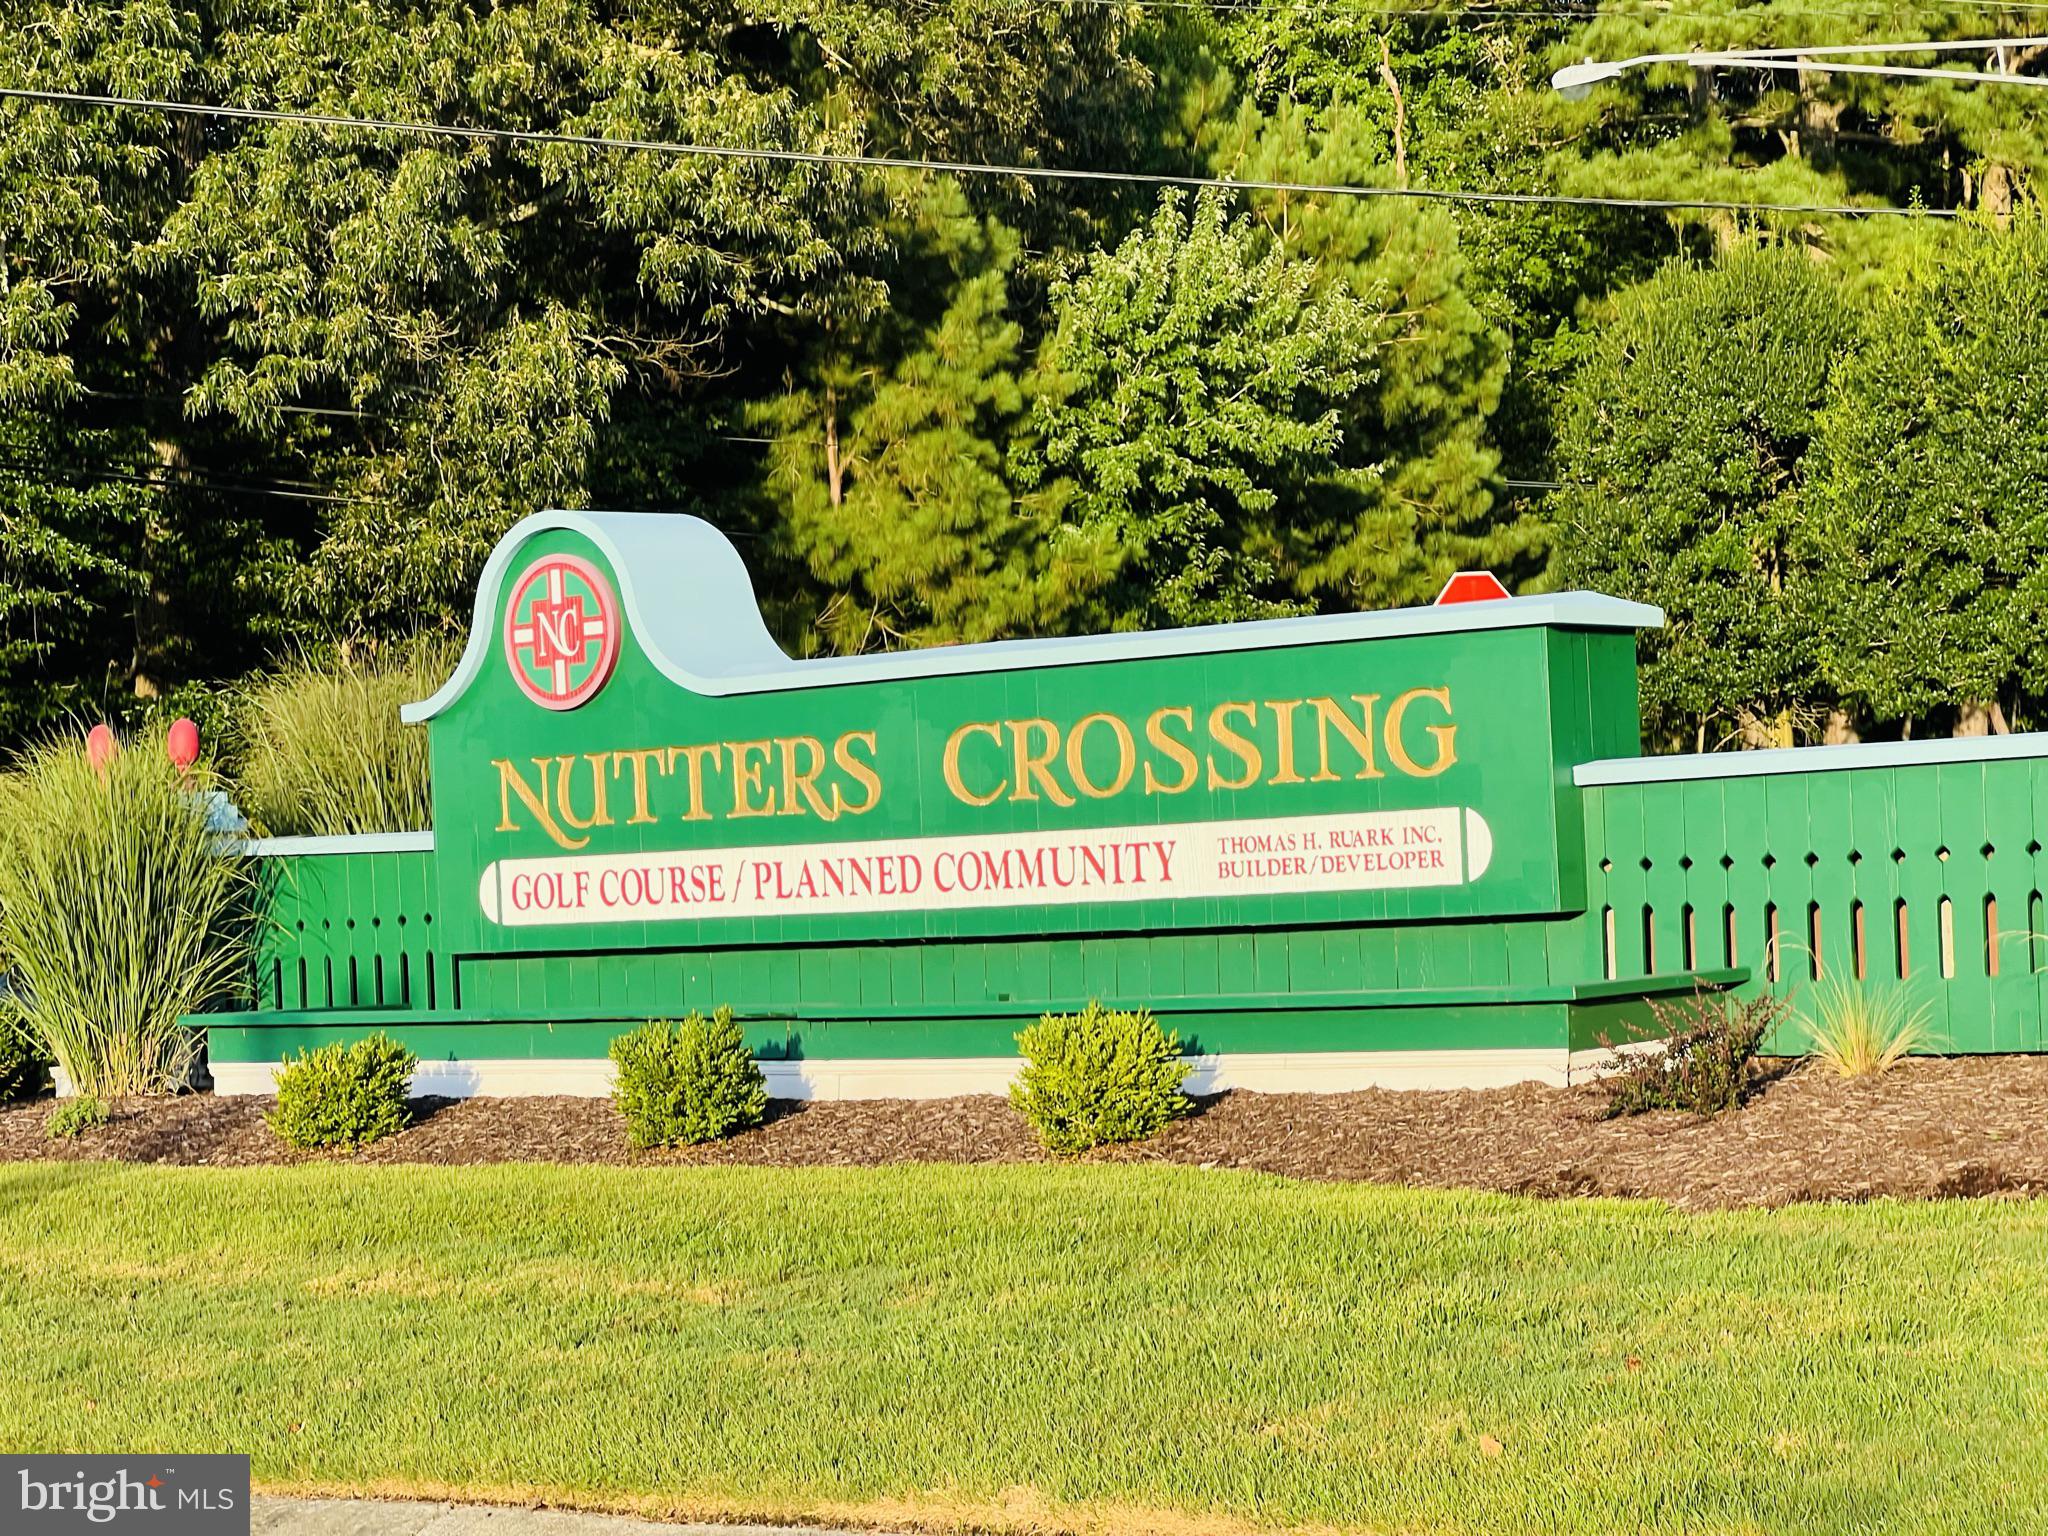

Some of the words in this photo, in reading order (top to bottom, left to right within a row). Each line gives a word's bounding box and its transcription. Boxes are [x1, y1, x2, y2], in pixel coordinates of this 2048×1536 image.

[537, 604, 580, 657] NC
[491, 730, 883, 850] NUTTERS
[943, 686, 1457, 807] CROSSING
[1217, 832, 1297, 855] THOMAS
[1303, 831, 1322, 850] H.
[1329, 826, 1395, 849] RUARK
[1403, 825, 1443, 845] INC.
[511, 870, 590, 911] GOLF
[933, 840, 1177, 893] COMMUNITY
